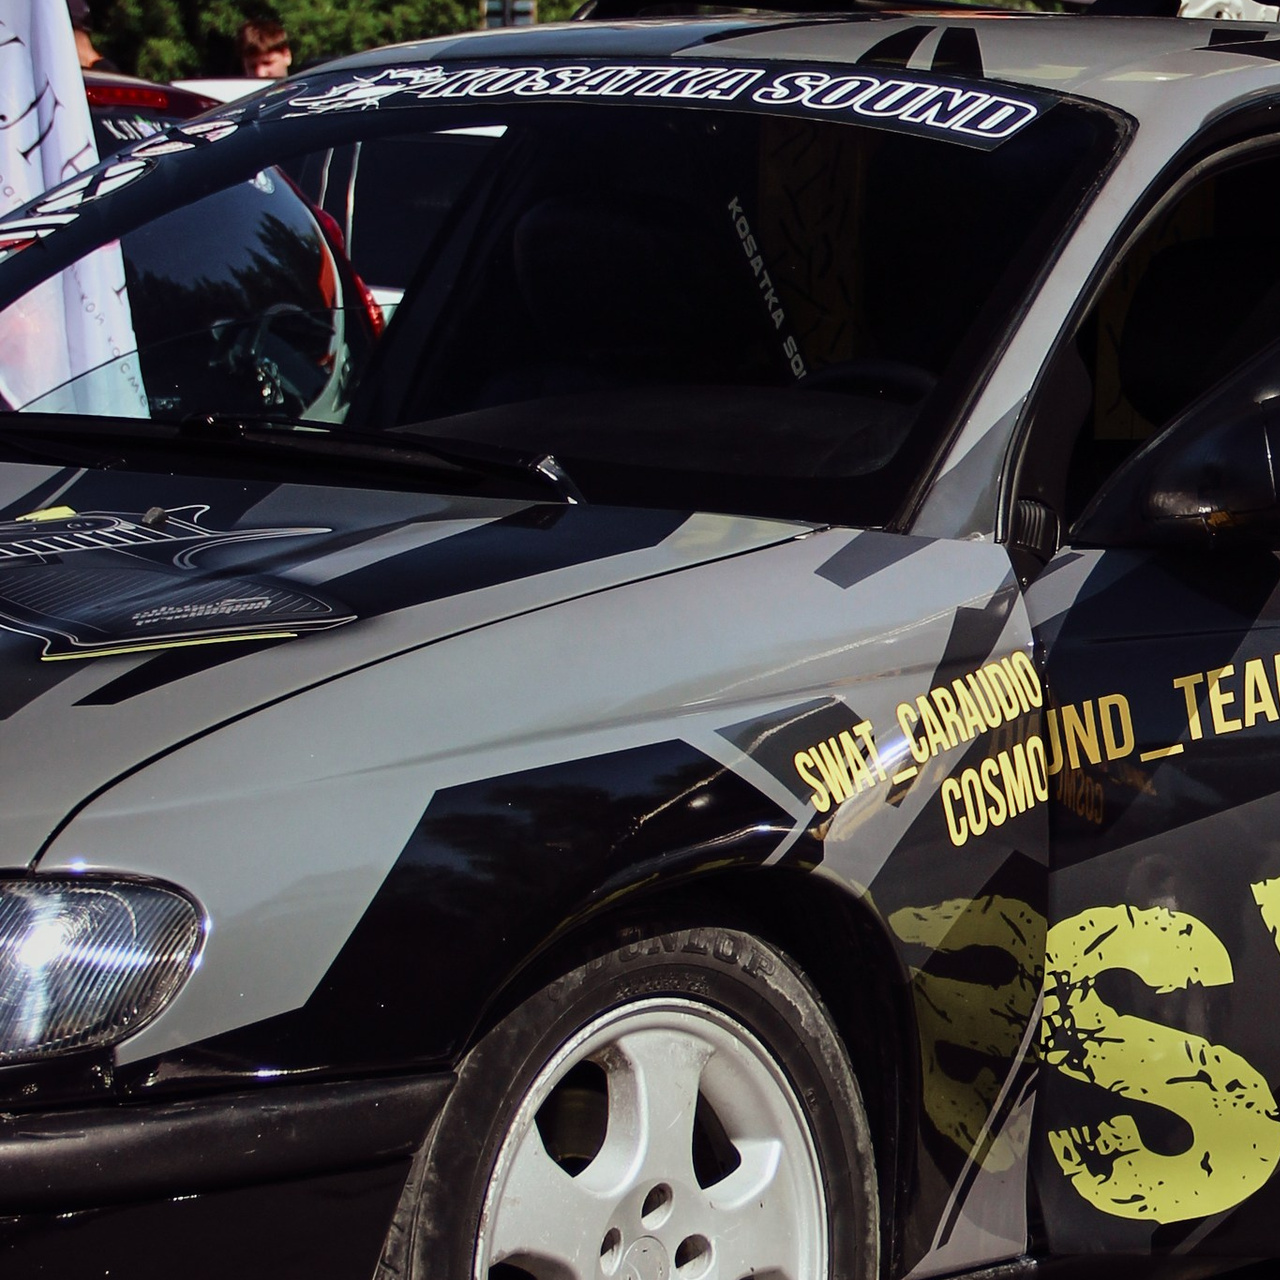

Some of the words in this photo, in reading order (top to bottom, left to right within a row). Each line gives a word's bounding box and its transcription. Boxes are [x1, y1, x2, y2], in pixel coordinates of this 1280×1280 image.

[424, 66, 765, 101] KOSATKA
[753, 71, 1038, 139] SOUND
[728, 196, 785, 330] KOSATKA
[940, 735, 1049, 847] COSMO
